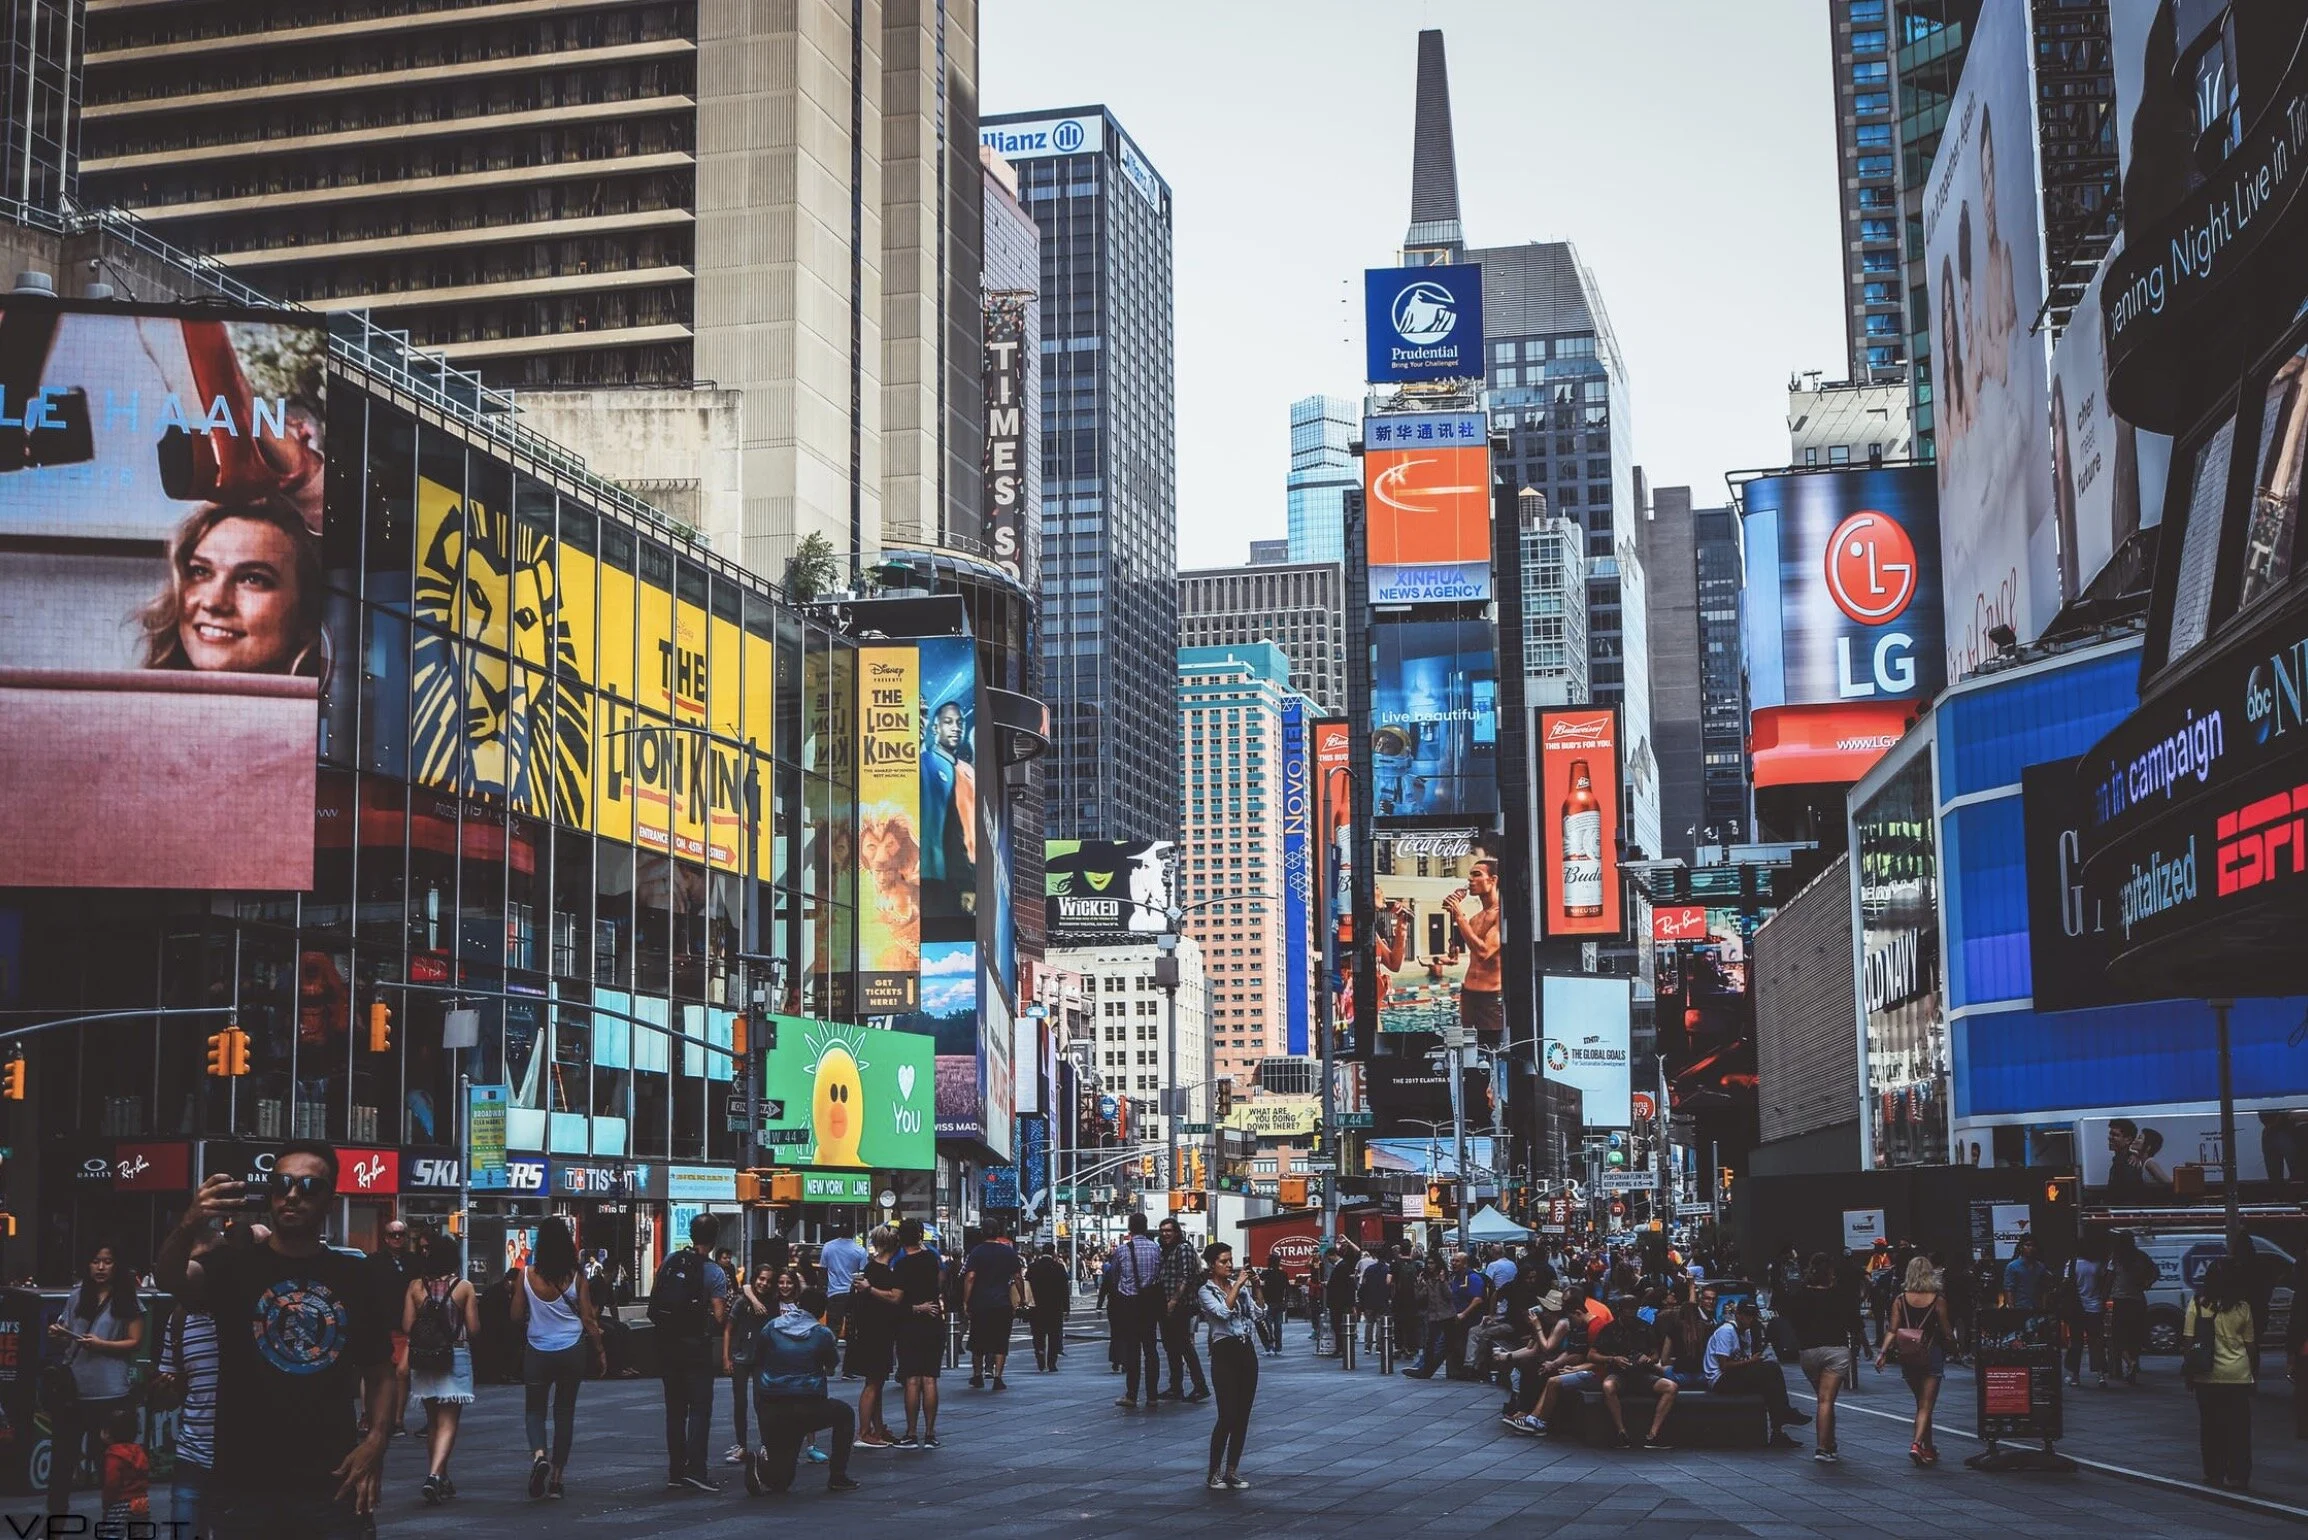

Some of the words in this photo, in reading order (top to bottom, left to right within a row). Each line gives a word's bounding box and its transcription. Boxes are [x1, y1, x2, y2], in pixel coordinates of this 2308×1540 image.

[983, 131, 1047, 152] llianz
[2172, 201, 2232, 286] Night
[2235, 165, 2270, 231] Live
[2272, 136, 2288, 186] in
[1391, 345, 1458, 361] Prudential
[1392, 361, 1408, 369] Bring
[104, 388, 286, 440] HAAN
[990, 341, 1019, 505] TIMES
[1376, 422, 1475, 442] 新华通讯社
[2078, 452, 2101, 499] future
[1395, 570, 1465, 587] XINHUA
[1379, 586, 1420, 600] NEWS
[1423, 584, 1482, 599] AGENCY
[659, 638, 706, 702] THE
[1837, 632, 1916, 699] LG
[872, 689, 903, 704] THE
[2247, 685, 2273, 723] abc
[866, 708, 909, 733] LION
[1382, 710, 1411, 723] Live
[1414, 709, 1480, 722] beautiful
[1552, 723, 1601, 735] Budweiser
[608, 683, 684, 802] LION
[863, 735, 916, 766] KING
[1562, 741, 1581, 750] BUD'S
[1583, 741, 1595, 749] FOR
[1597, 740, 1612, 748] YOU.
[1319, 754, 1333, 762] THIS
[2111, 759, 2126, 817] in
[2129, 708, 2224, 805] campaign
[1281, 723, 1304, 835] NOVOTEL
[639, 825, 668, 846] ENTRANCE
[676, 837, 686, 849] ON
[688, 841, 703, 855] 45TH
[709, 847, 728, 862] STREET
[1864, 950, 1884, 1014] OLD
[1885, 927, 1918, 1006] NAVY
[874, 979, 893, 987] GET
[865, 988, 902, 996] TICKETS
[870, 998, 898, 1006] HERE!
[1572, 1049, 1583, 1060] THE
[1583, 1049, 1606, 1060] GLOBAL
[1607, 1050, 1626, 1061] GOALS
[474, 1110, 505, 1118] BROADWAY
[892, 1101, 921, 1134] YOU
[1249, 1107, 1270, 1115] WHAT
[1254, 1115, 1270, 1123] YOU
[1272, 1114, 1296, 1122] DOING
[1247, 1123, 1270, 1131] DOWN
[1273, 1122, 1300, 1130] THERE?
[1338, 1115, 1346, 1125] W
[1349, 1114, 1362, 1125] 44
[772, 1131, 781, 1142] W
[785, 1131, 797, 1142] 44
[410, 1158, 545, 1190] SKERS
[807, 1180, 824, 1195] NEW
[824, 1180, 844, 1195] YORK
[852, 1181, 868, 1196] LINE
